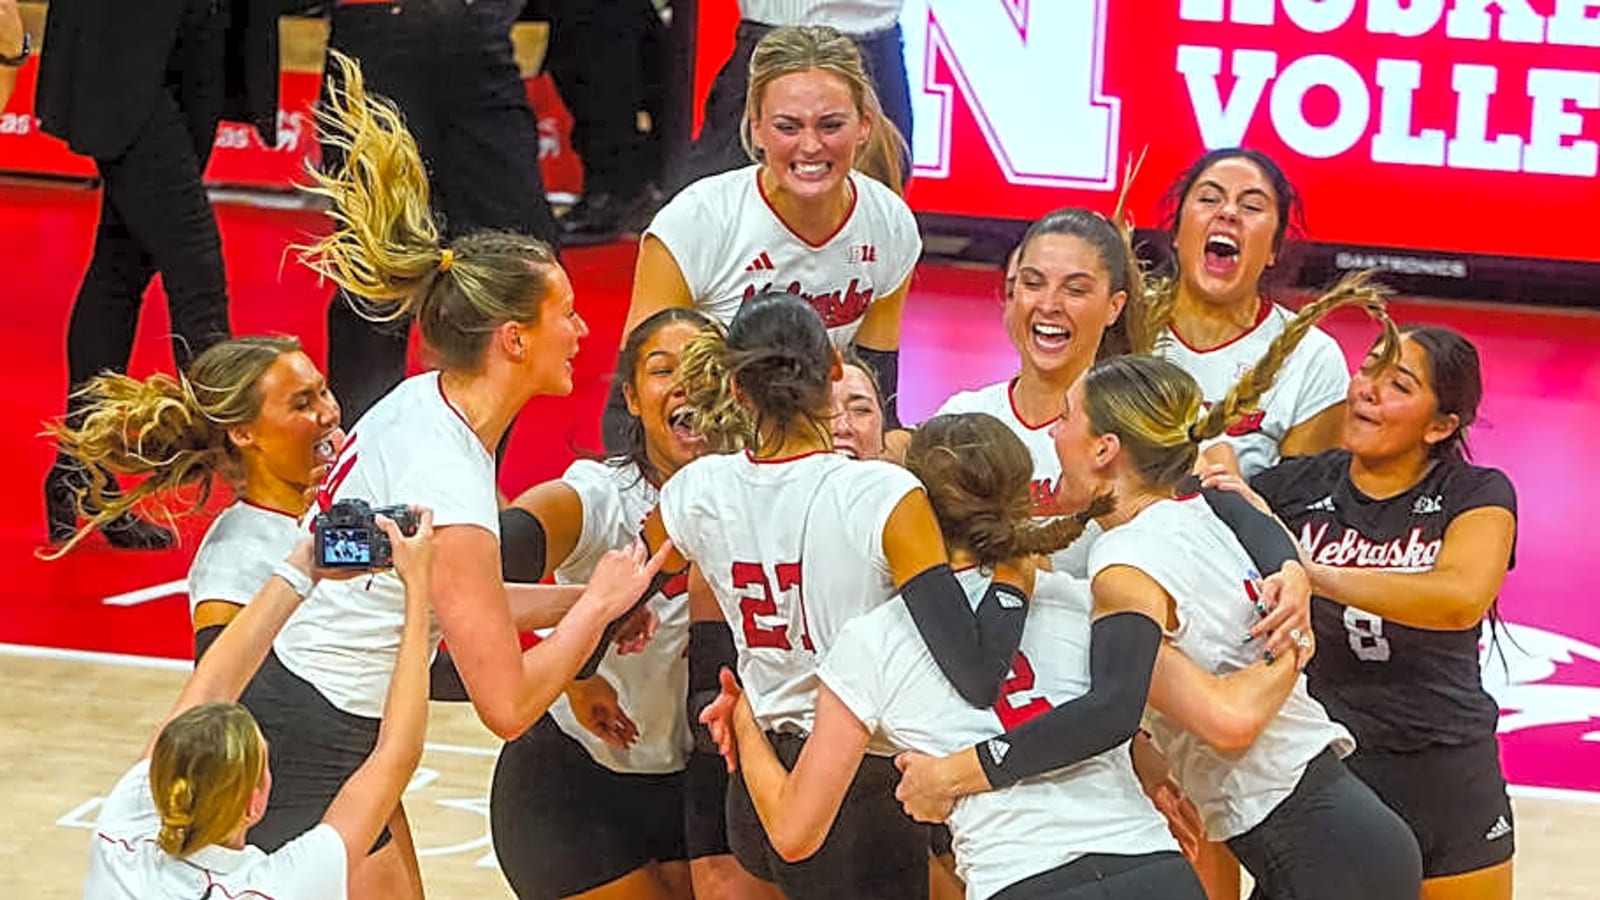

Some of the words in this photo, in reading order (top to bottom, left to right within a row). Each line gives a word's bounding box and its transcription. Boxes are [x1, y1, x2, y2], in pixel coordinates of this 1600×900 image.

[1176, 45, 1600, 177] VOLLE
[1300, 521, 1443, 573] Nebraska
[1343, 605, 1392, 662] 8
